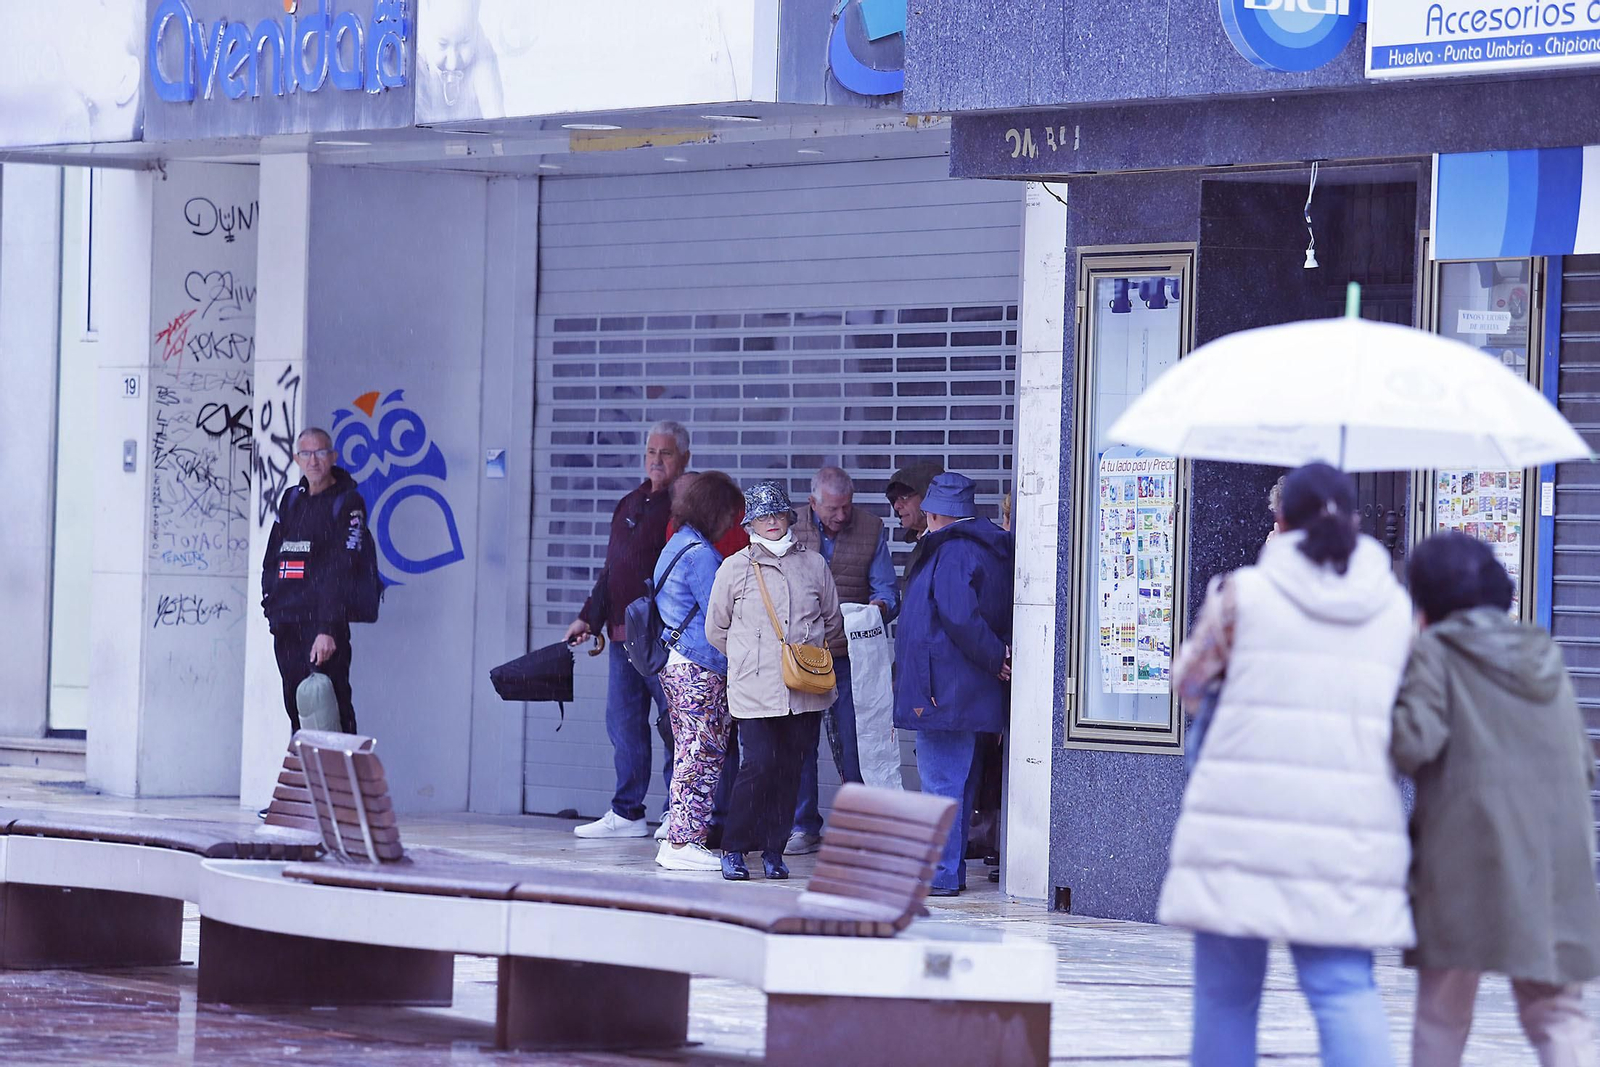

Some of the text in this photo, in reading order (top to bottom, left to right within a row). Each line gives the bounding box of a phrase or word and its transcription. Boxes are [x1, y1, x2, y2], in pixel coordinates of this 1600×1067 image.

[1425, 0, 1576, 36] Accesorios
[1388, 48, 1433, 66] Huelva
[1443, 45, 1482, 62] Punta
[1486, 39, 1533, 59] Umbría
[124, 377, 136, 395] 19
[1101, 461, 1106, 472] A
[1107, 461, 1115, 472] tu
[1116, 460, 1131, 472] lado
[851, 627, 882, 640] ALE-HOP
